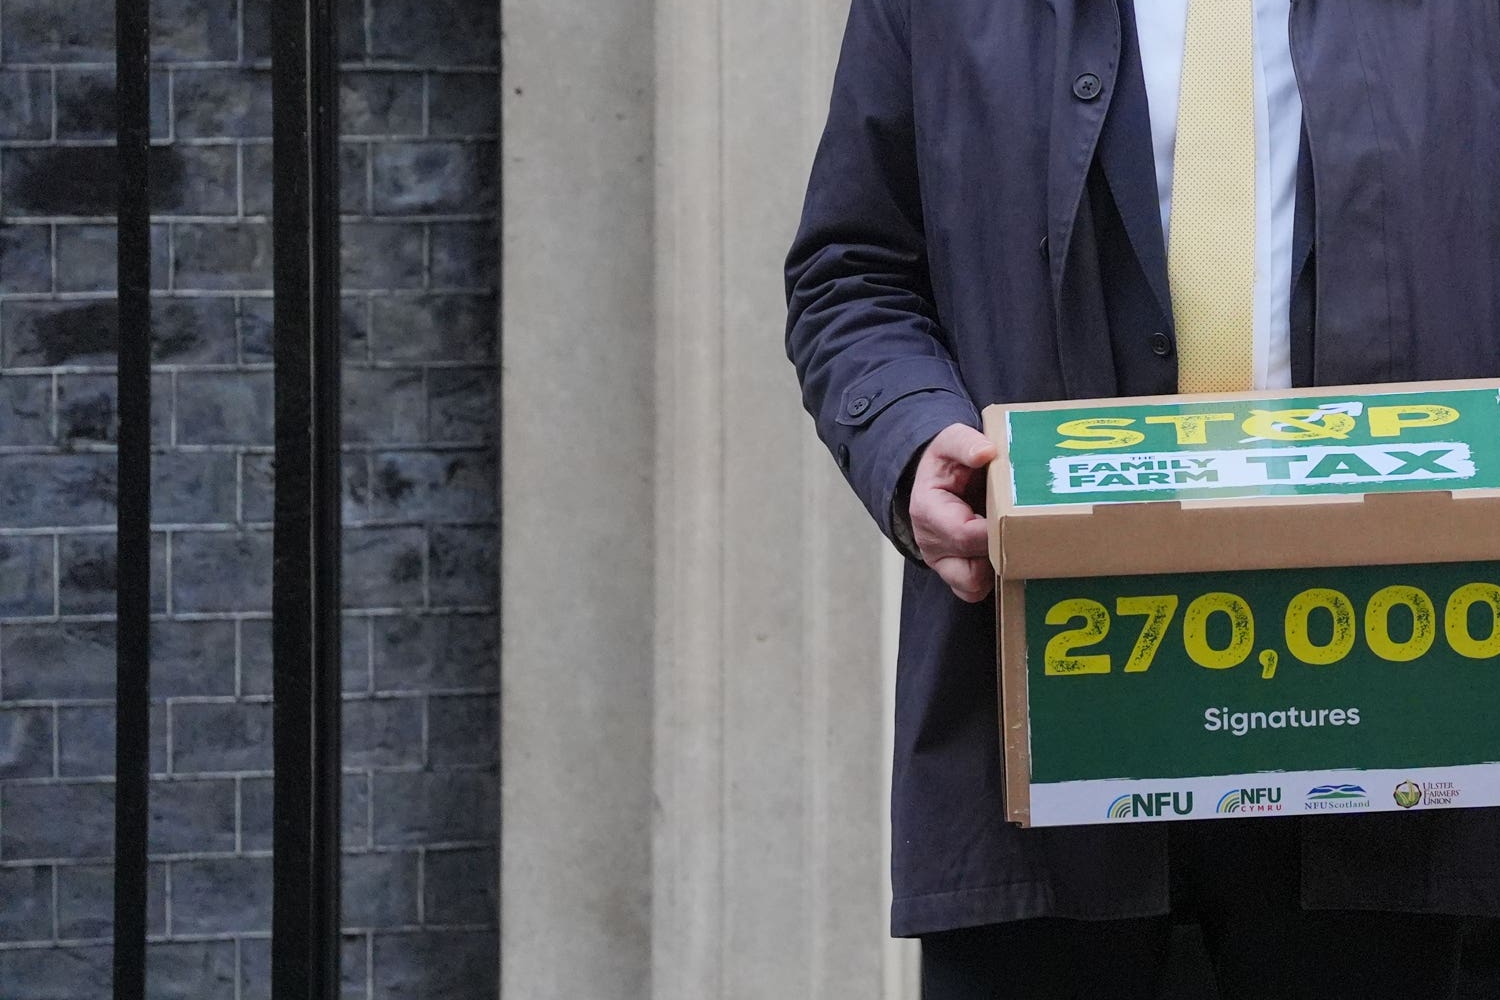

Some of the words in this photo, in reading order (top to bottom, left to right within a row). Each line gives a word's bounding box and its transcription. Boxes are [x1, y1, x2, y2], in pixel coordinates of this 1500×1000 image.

[1055, 404, 1460, 450] STOP
[1068, 457, 1216, 474] FAMILY
[1245, 449, 1456, 481] TAX
[1068, 469, 1219, 488] FARM
[1203, 704, 1361, 737] Signatures
[1132, 791, 1193, 818] NFU
[1240, 787, 1282, 805] NFU
[1240, 804, 1282, 813] CYMRU
